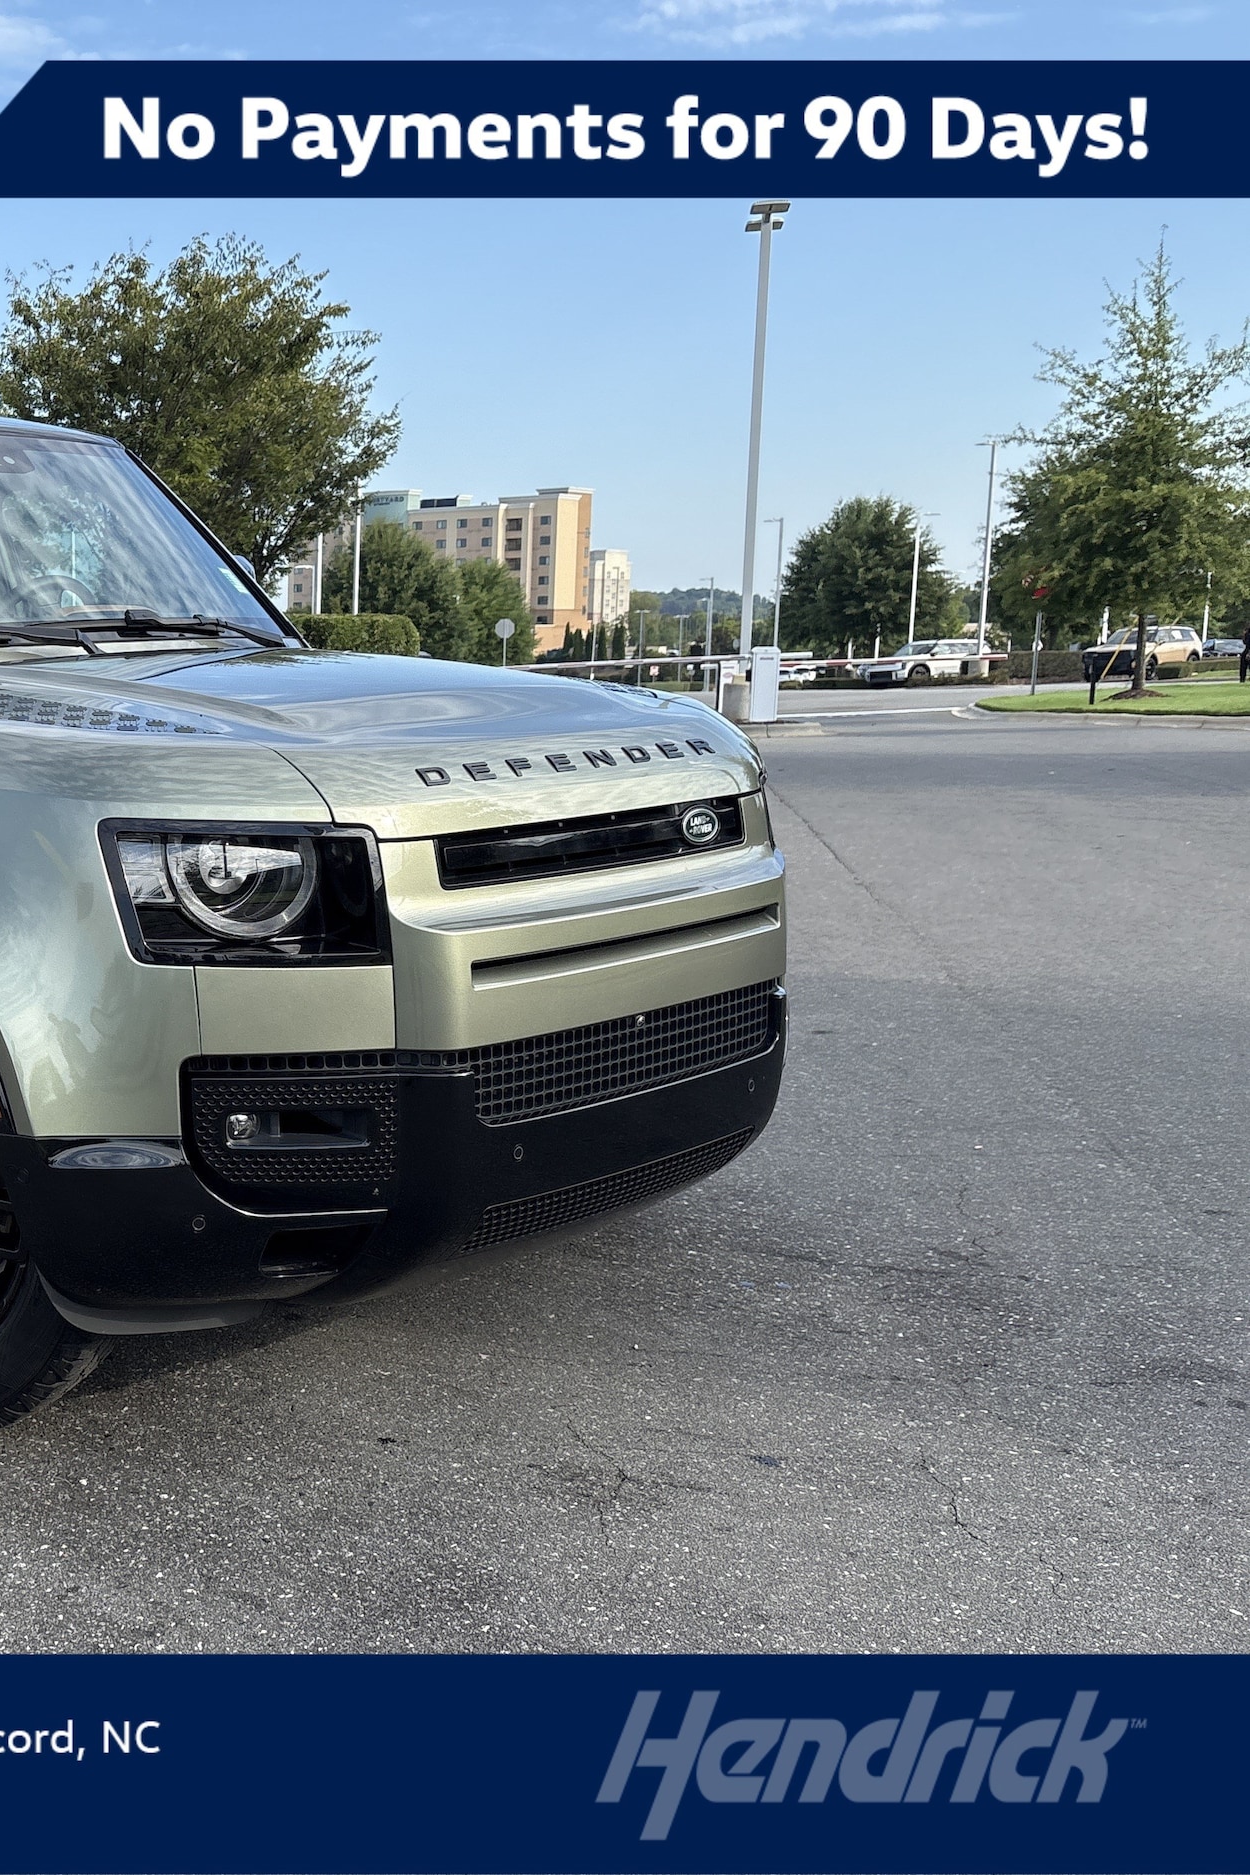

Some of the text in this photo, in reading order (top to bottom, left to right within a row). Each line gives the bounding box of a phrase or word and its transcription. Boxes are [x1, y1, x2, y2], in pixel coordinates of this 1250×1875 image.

[415, 738, 716, 787] DEFENDER
[689, 815, 707, 827] LAND
[692, 823, 713, 836] ROVER
